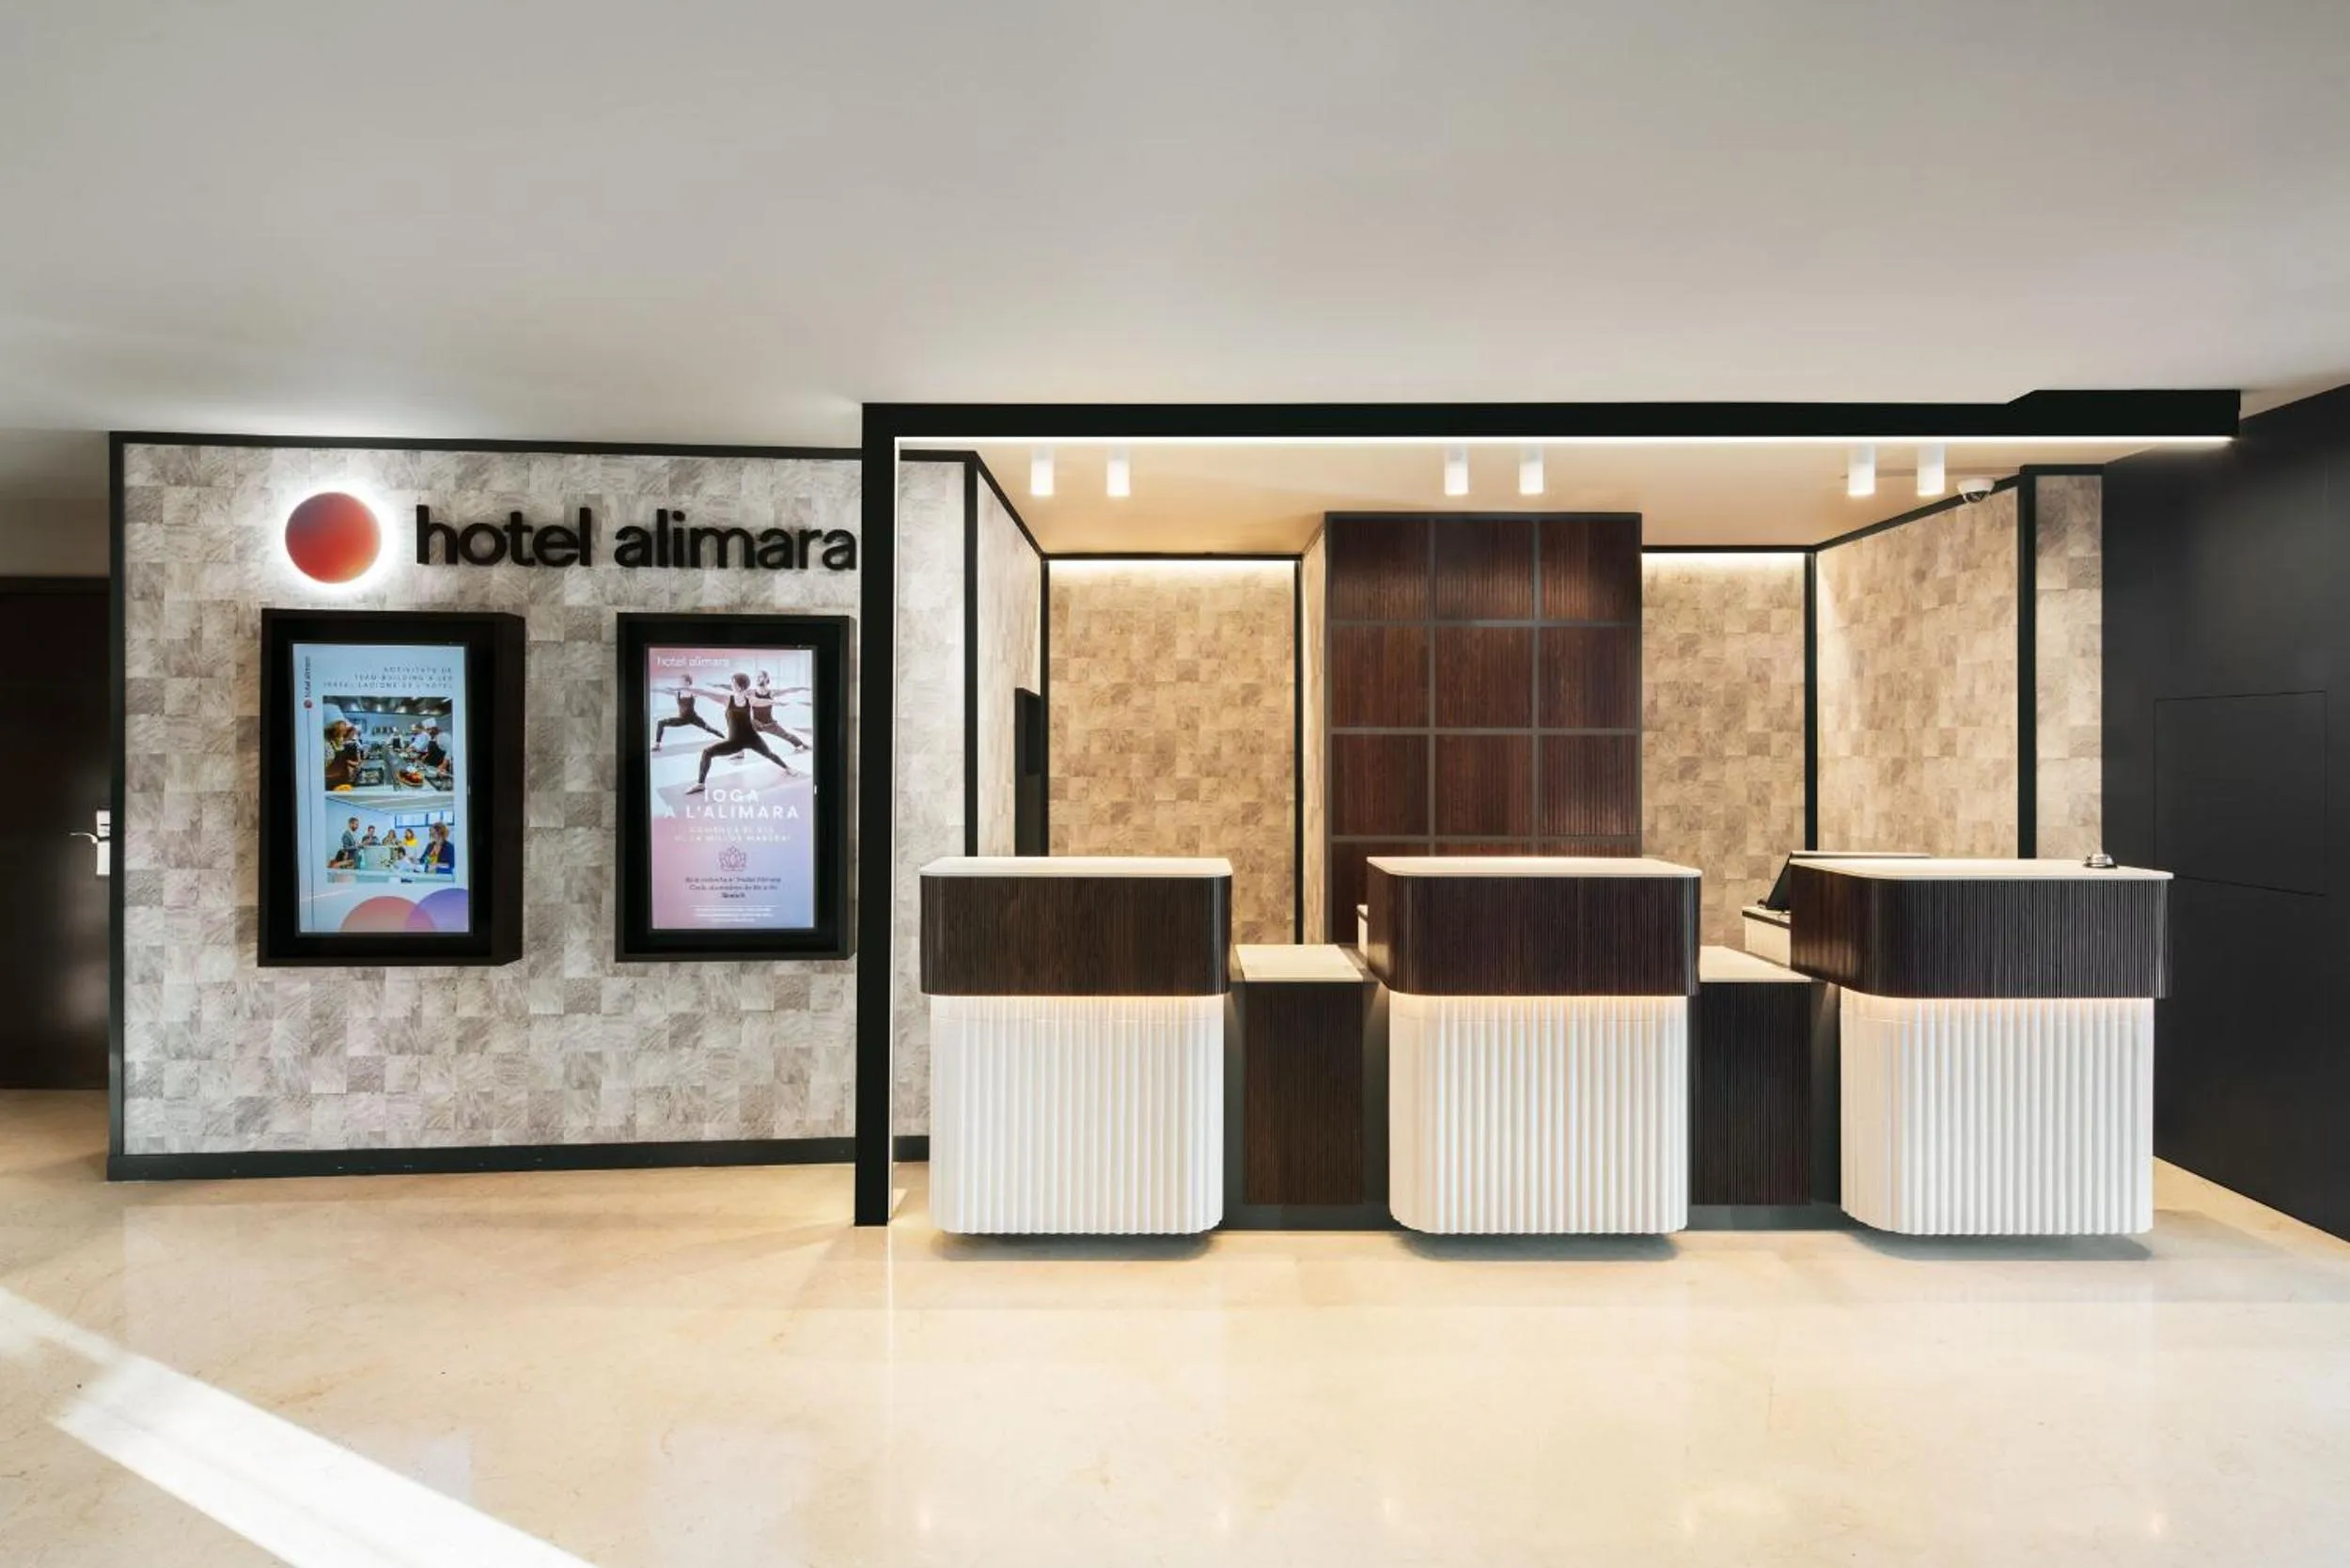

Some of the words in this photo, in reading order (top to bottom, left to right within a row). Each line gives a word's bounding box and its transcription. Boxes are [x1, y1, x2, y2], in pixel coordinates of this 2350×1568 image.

[415, 504, 592, 568] hotel
[613, 508, 857, 571] alimara
[657, 655, 686, 667] hotel
[688, 655, 729, 667] alimara
[704, 788, 760, 803] IOGA
[663, 805, 676, 819] A
[686, 805, 799, 820] L'ALIMARA
